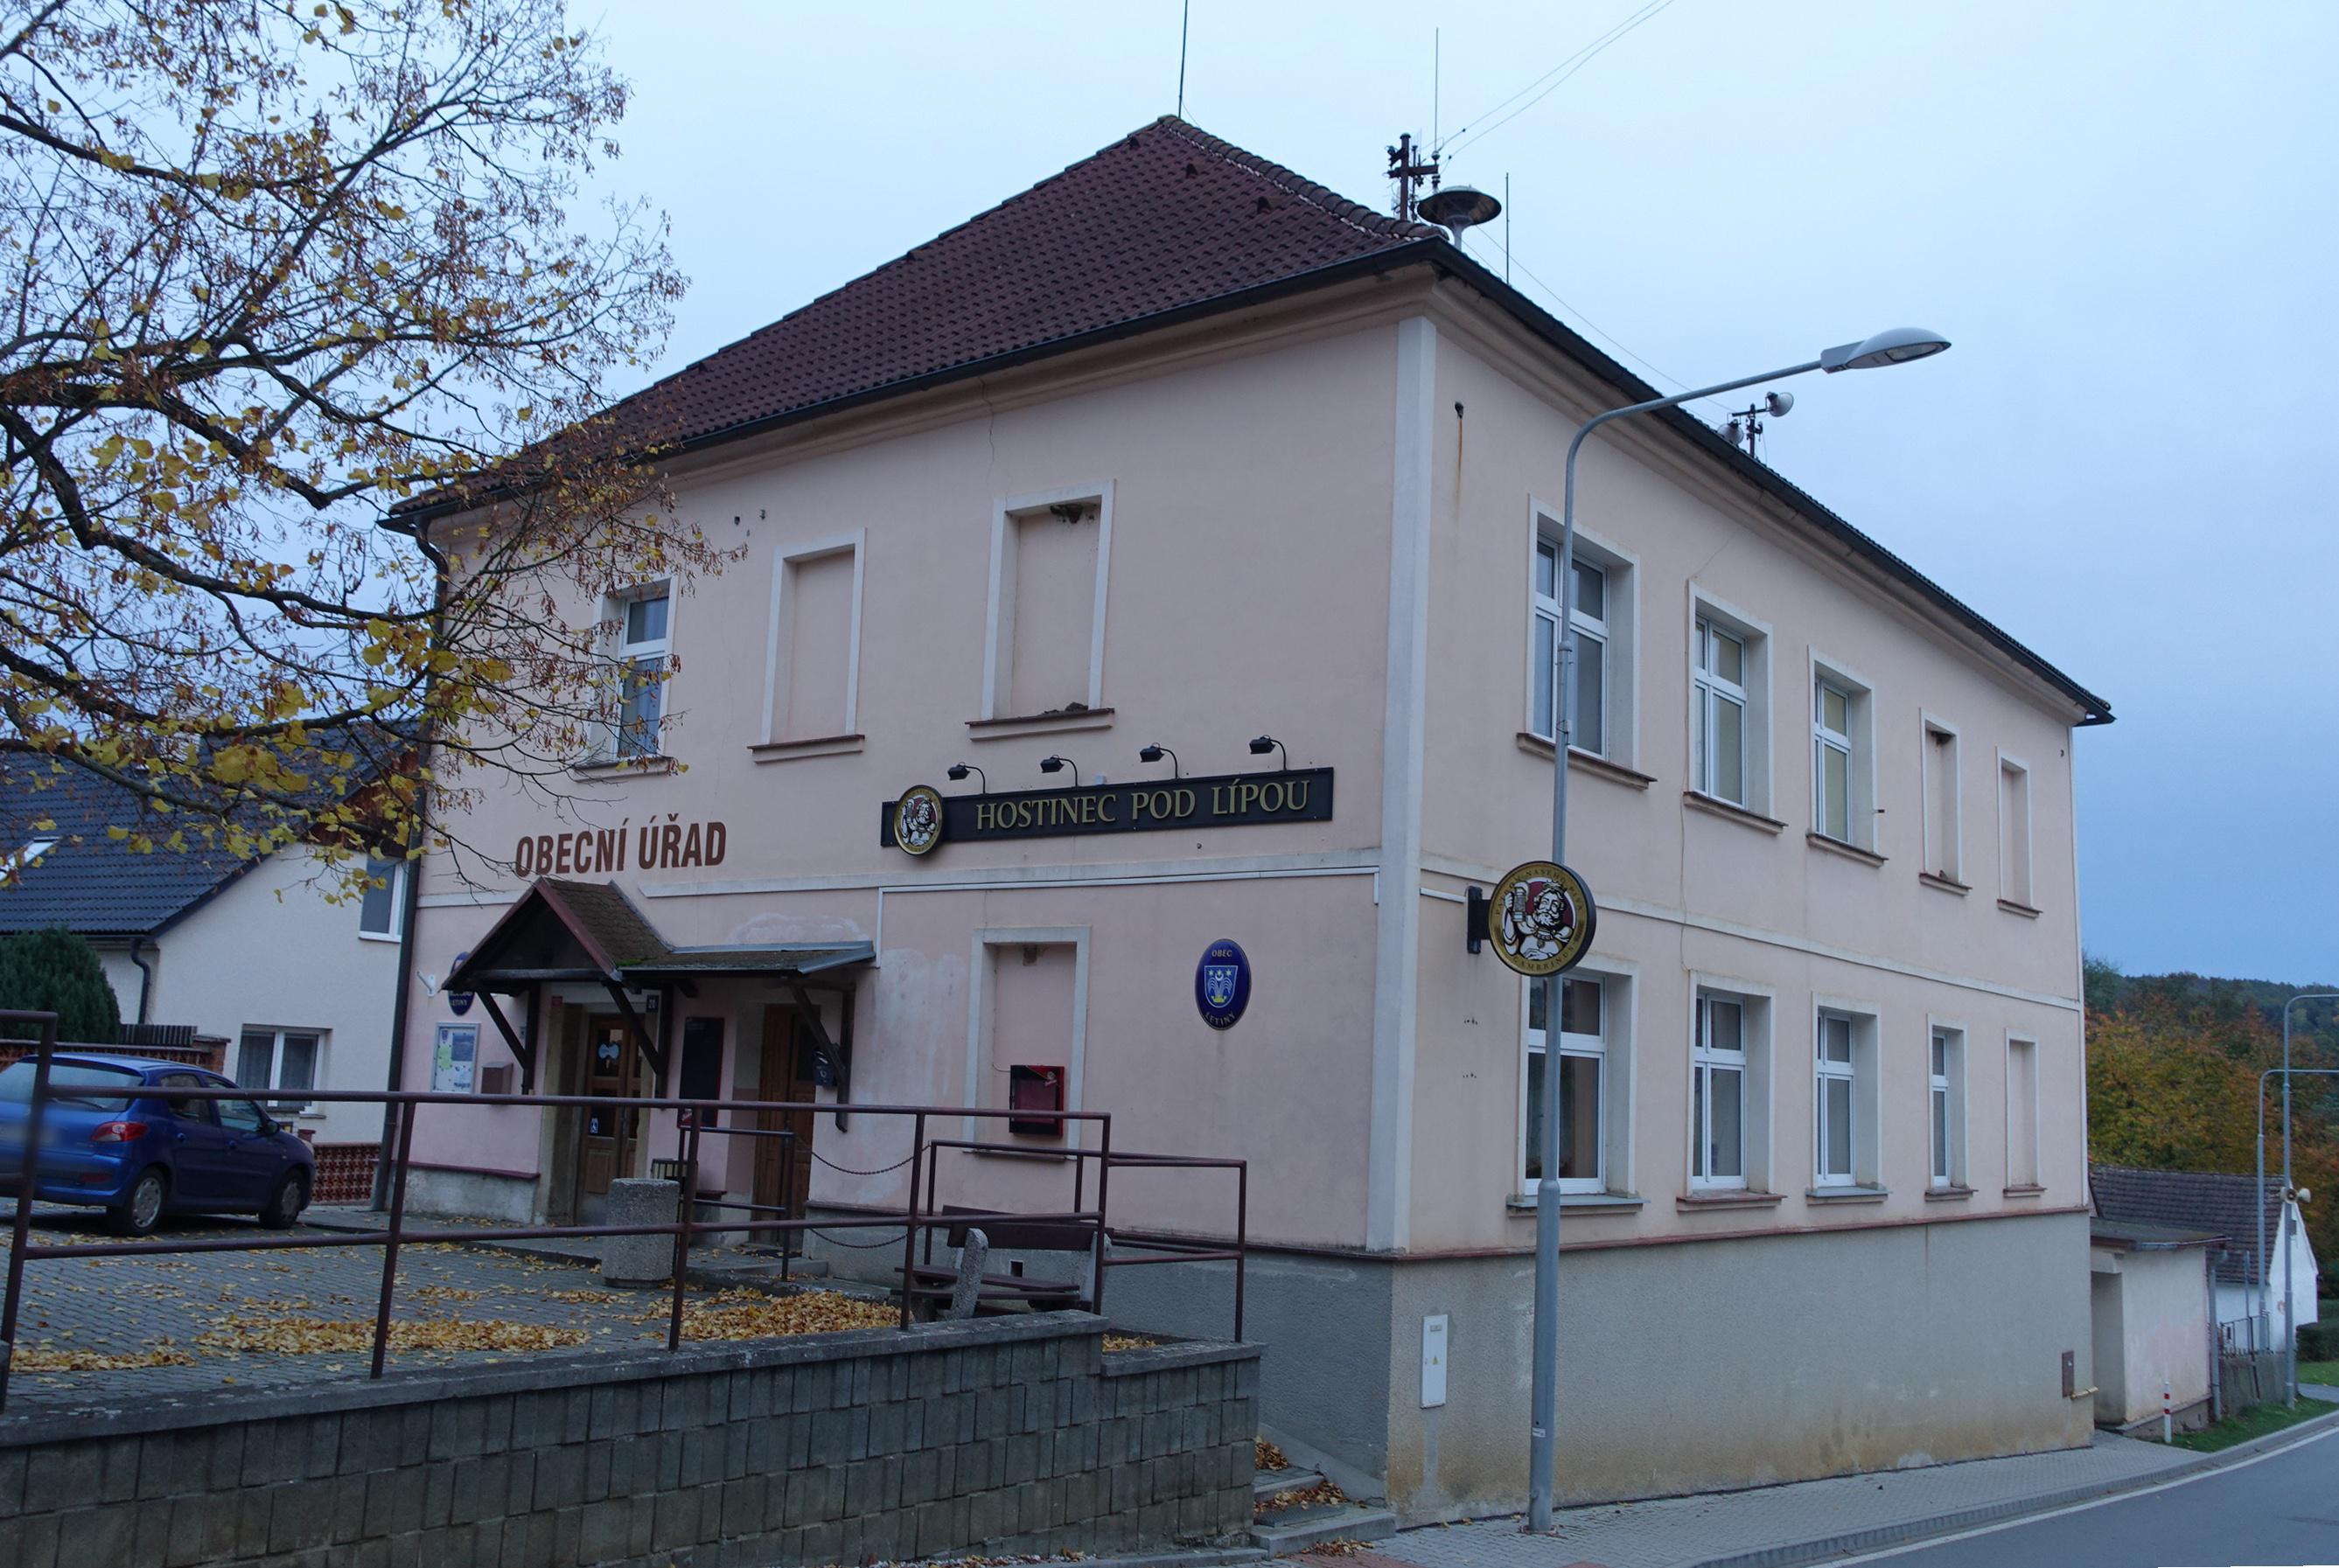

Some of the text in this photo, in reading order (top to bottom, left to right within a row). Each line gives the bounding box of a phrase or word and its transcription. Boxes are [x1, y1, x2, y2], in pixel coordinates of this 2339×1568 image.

[976, 794, 1116, 830] HOSTINEC
[1131, 789, 1196, 819] POD
[1211, 778, 1310, 815] LÍPOU
[515, 812, 727, 877] OBECNÍ ÚŘAD
